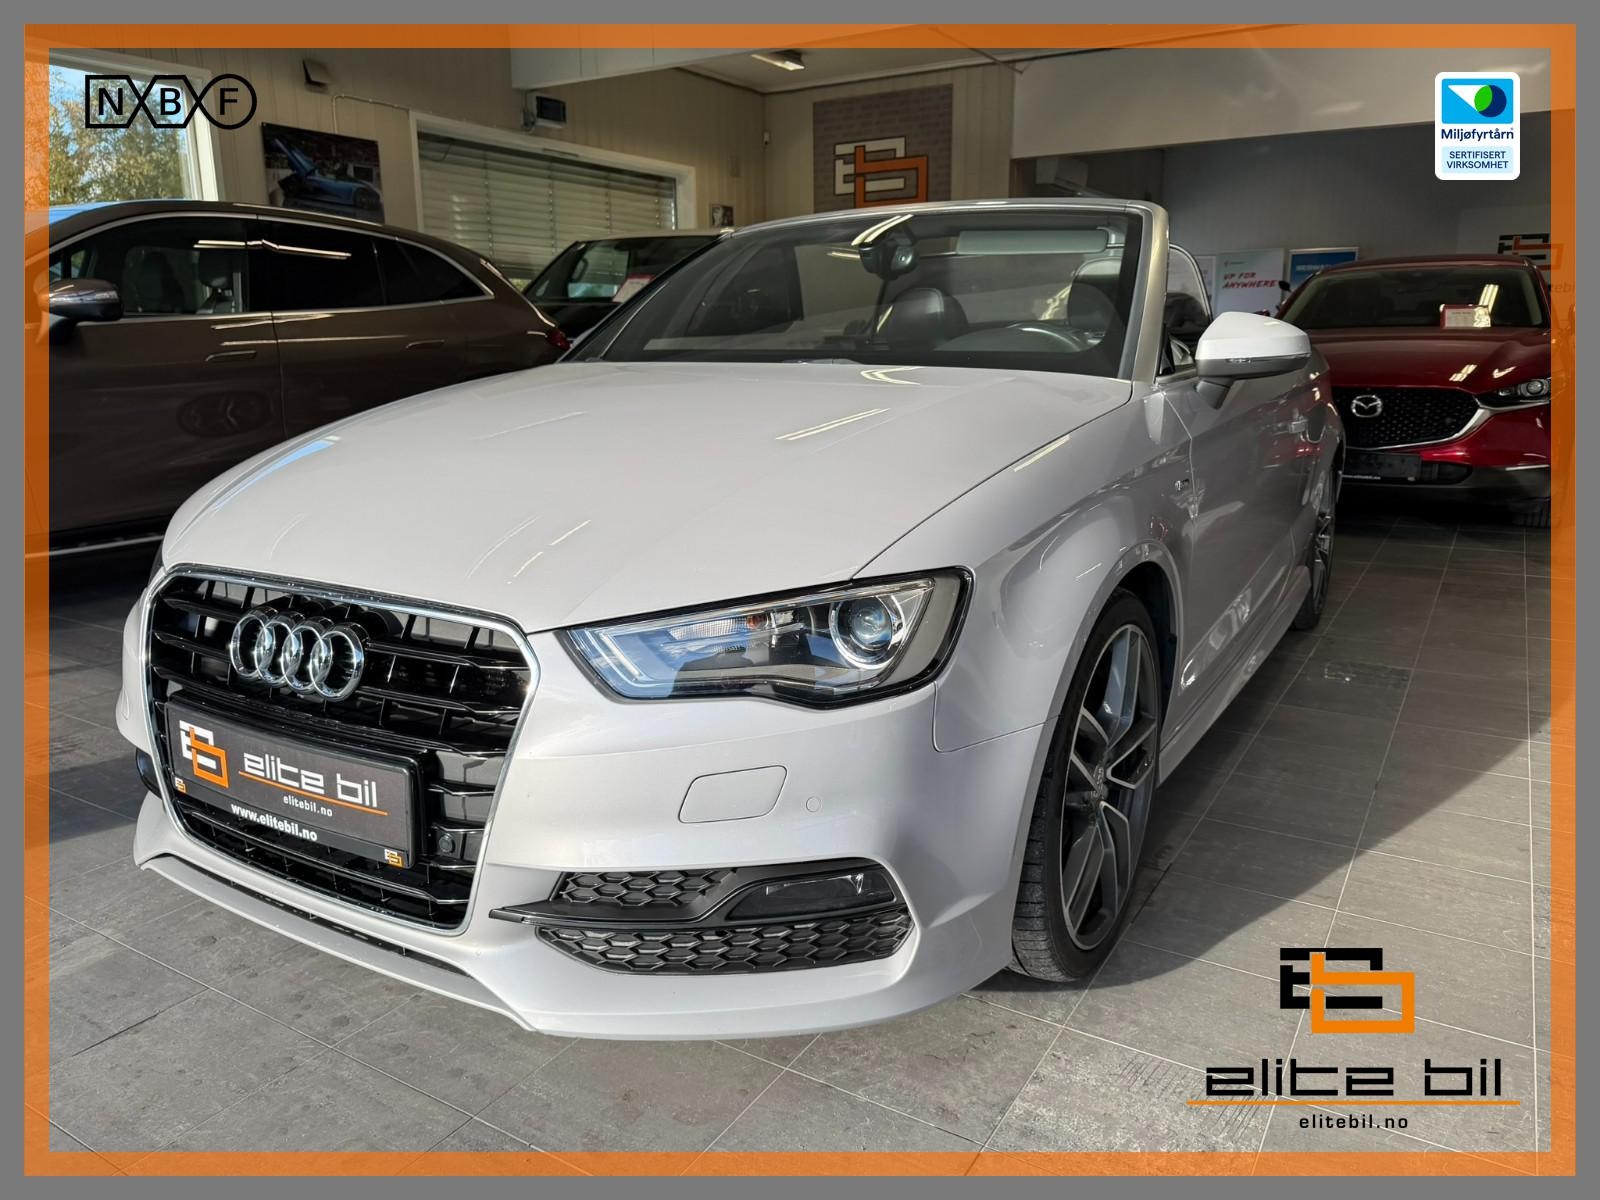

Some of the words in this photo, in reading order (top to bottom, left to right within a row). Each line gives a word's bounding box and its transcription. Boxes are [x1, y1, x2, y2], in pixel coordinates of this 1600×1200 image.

[1222, 280, 1278, 289] ANYWHERE
[243, 752, 325, 794] elite
[336, 773, 377, 808] bil
[283, 794, 333, 817] elitebil.no
[230, 803, 318, 842] www.elitebil.no
